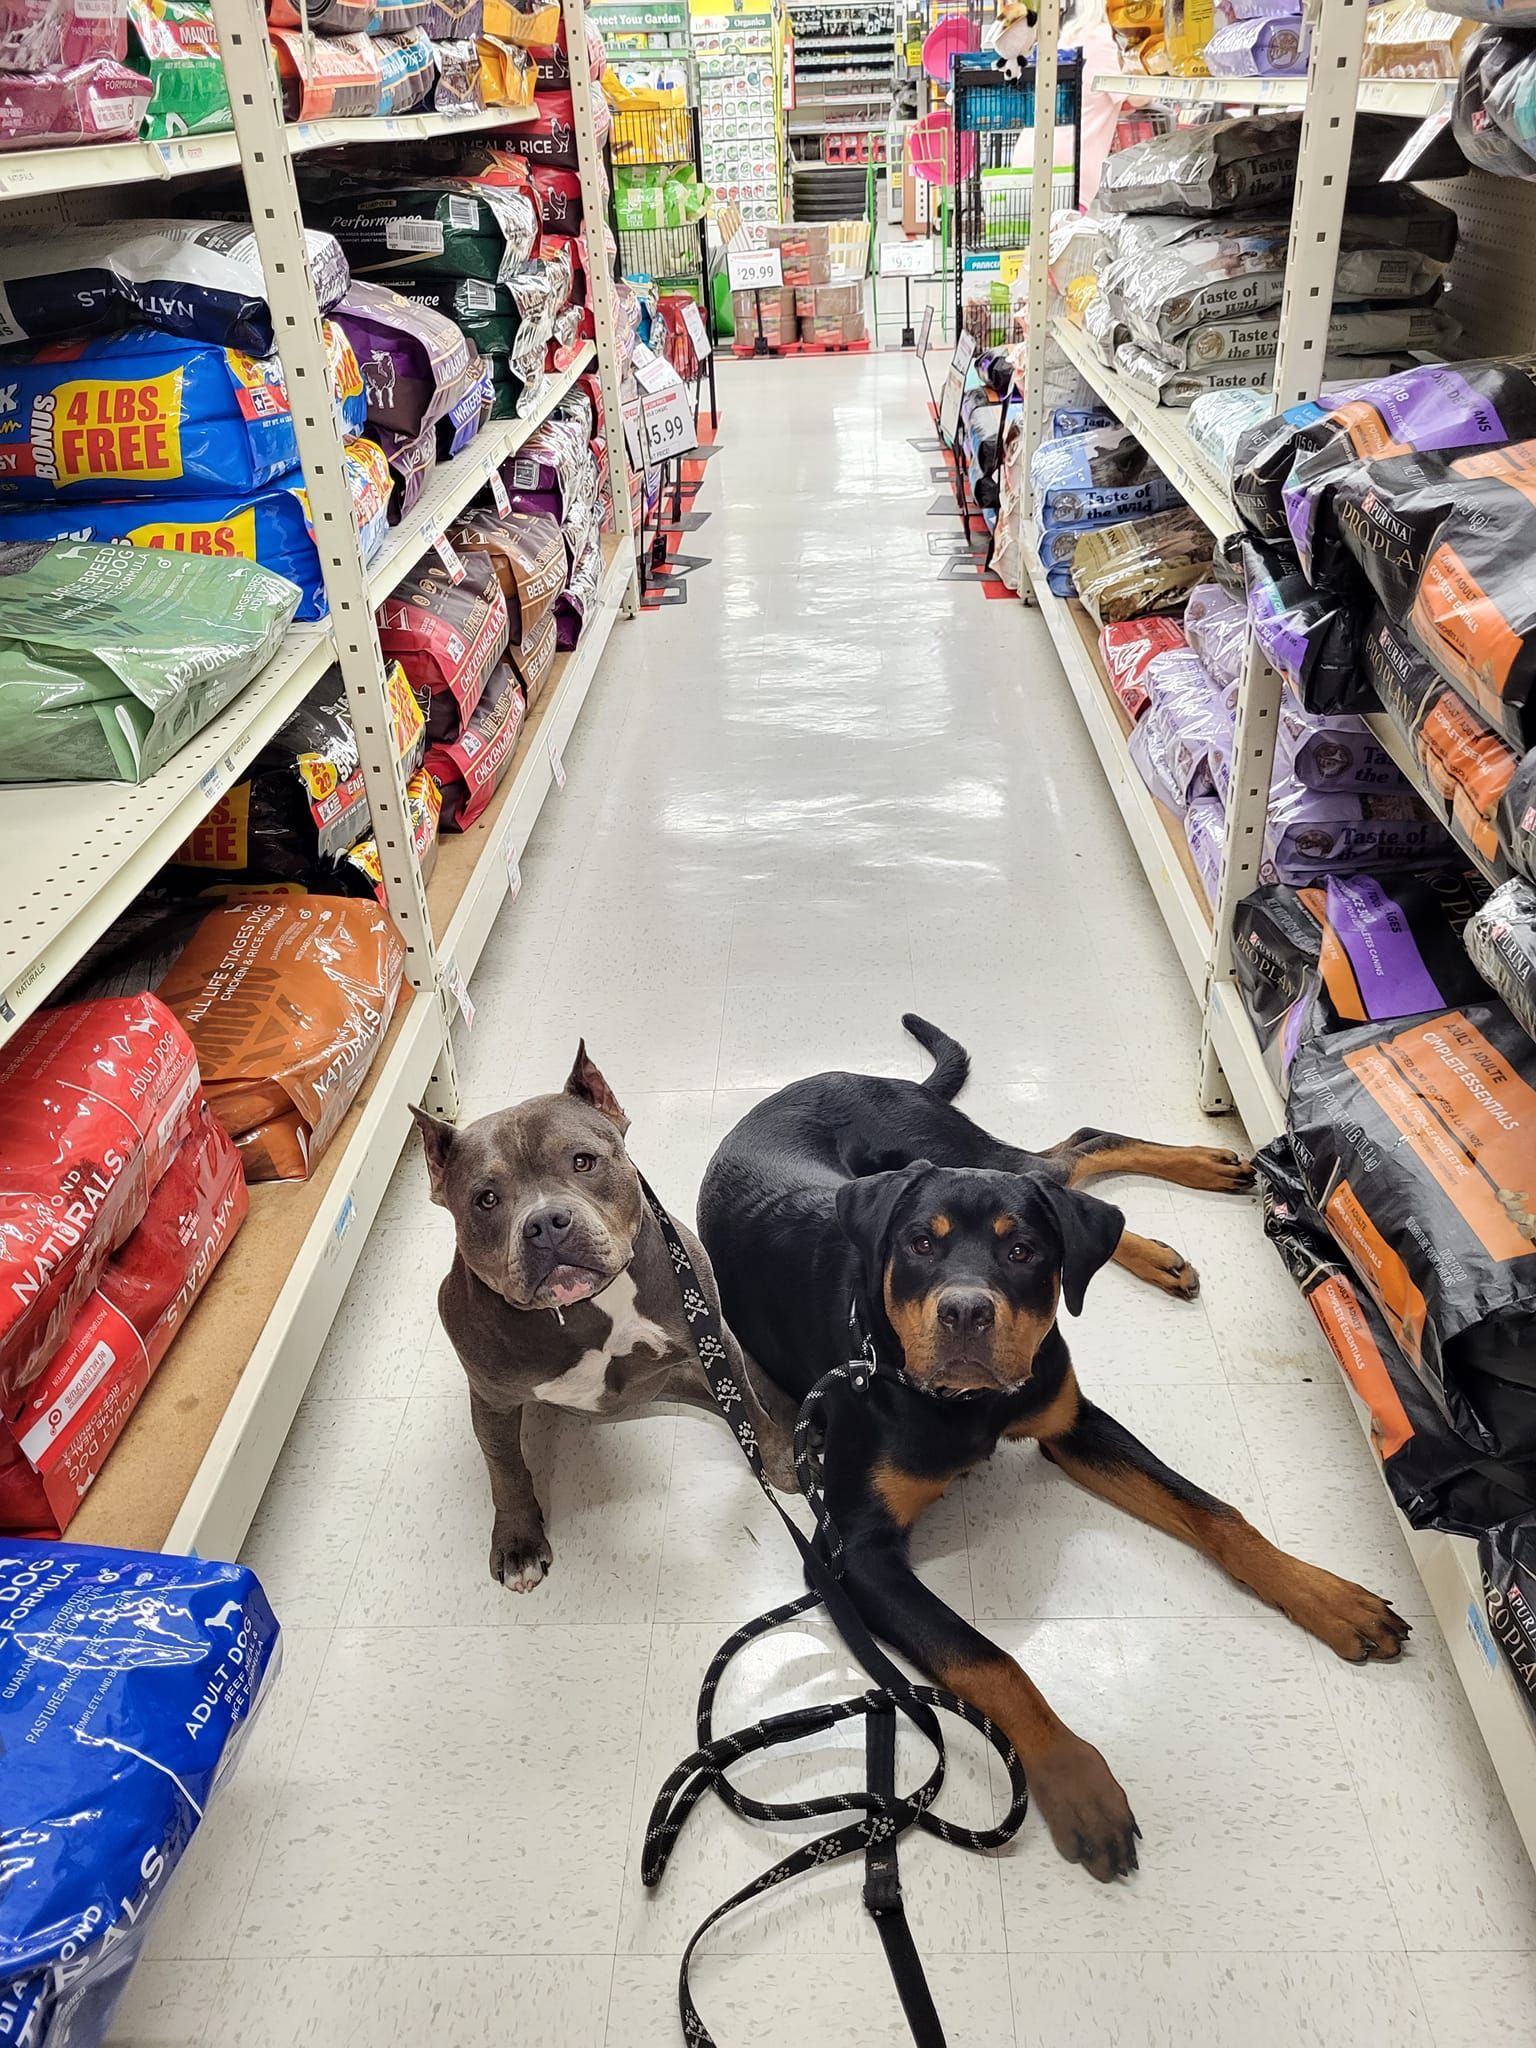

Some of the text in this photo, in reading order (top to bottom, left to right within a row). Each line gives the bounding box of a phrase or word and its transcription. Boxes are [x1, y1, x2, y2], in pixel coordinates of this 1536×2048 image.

[619, 14, 680, 24] Your Garden
[505, 140, 516, 152] &
[520, 140, 552, 153] RICE
[1247, 156, 1294, 175] Taste
[1248, 177, 1274, 195] the
[1200, 288, 1238, 305] Taste
[1243, 282, 1259, 298] of
[1228, 343, 1250, 358] the
[1230, 329, 1267, 343] Taste
[1207, 372, 1268, 387] Taste of
[66, 385, 167, 426] 4 LBS.
[1082, 417, 1111, 428] Taste
[31, 394, 57, 480] BONUS
[62, 426, 170, 474] FREE
[1252, 430, 1270, 447] NET
[1086, 487, 1151, 505] Taste of
[1087, 503, 1151, 519] the Wild
[1342, 500, 1371, 540] PRO
[1369, 504, 1409, 540] PURINA
[81, 547, 116, 586] BREED
[108, 549, 135, 579] DOG
[117, 552, 150, 592] FORMULA
[231, 593, 252, 621] LARGE
[526, 581, 545, 599] BEEF
[1383, 638, 1411, 680] PURINA
[1341, 825, 1427, 844] Taste of
[188, 899, 270, 1023] ALL LIFE STAGES DOG
[221, 964, 248, 1003] CHICKEN
[246, 935, 264, 958] RICE
[257, 905, 286, 937] FORMULA
[1232, 933, 1296, 997] PRO PLAN
[1367, 949, 1384, 976] CANINS
[1500, 931, 1531, 980] PURINA
[15, 962, 46, 997] NATURALS
[128, 1031, 175, 1102] ADULT DOG
[160, 1054, 189, 1087] FORMULA
[311, 1008, 381, 1100] NATURALS
[1470, 1049, 1506, 1086] ADULTE
[1458, 1070, 1518, 1133] ESSENTIALS
[1360, 1153, 1381, 1173] kg)
[23, 1169, 82, 1245] DIAMOND
[11, 1148, 125, 1306] NATURALS
[166, 1190, 236, 1329] NATURALS
[1433, 1261, 1455, 1287] CHIENS
[1439, 1248, 1466, 1282] DOG FOOD
[1322, 1284, 1346, 1322] COMPLETE
[1338, 1322, 1366, 1369] ESSENTIALS
[93, 1397, 120, 1430] LAMB
[100, 1383, 121, 1409] RICE
[66, 1384, 141, 1482] ADULT DOG
[72, 1427, 96, 1458] MEAL
[0, 1559, 54, 1601] DOG
[0, 1562, 80, 1631] FORMULA
[49, 1580, 92, 1635] PROBIOTICS
[1482, 1568, 1509, 1630] PRO
[184, 1615, 253, 1740] ADULT DOG
[223, 1671, 247, 1705] BEEF
[231, 1694, 246, 1722] RICE
[0, 1905, 102, 2034] DIAOND
